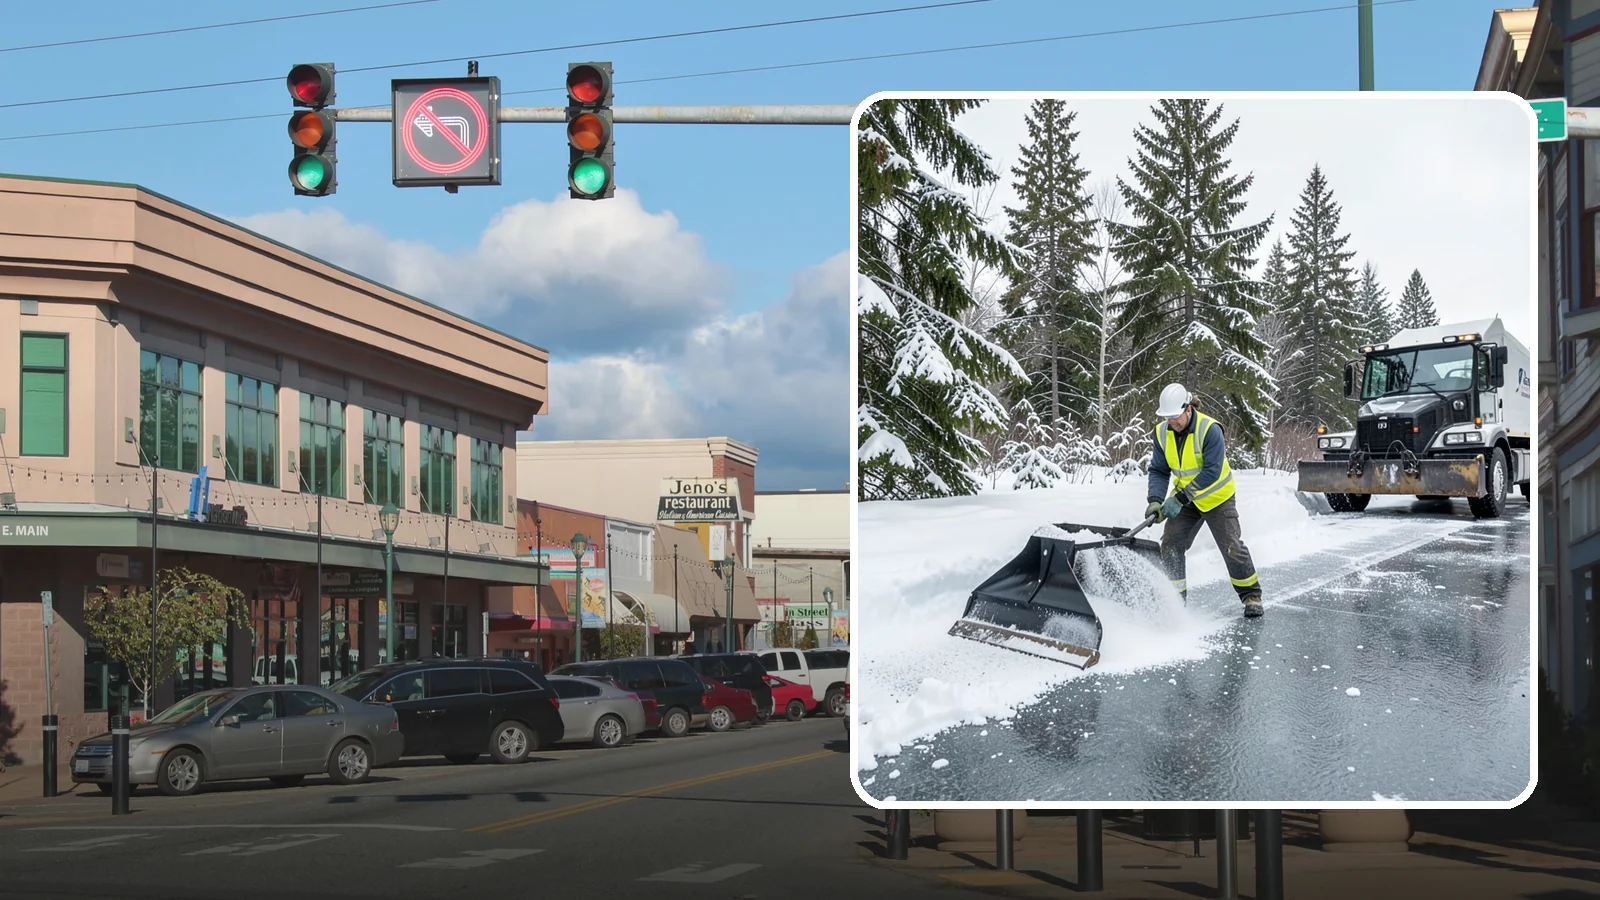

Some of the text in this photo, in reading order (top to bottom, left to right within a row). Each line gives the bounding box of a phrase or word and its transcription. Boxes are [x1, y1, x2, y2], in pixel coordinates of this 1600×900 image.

[670, 480, 728, 494] Jeno's
[665, 496, 731, 508] restaurant
[658, 510, 680, 519] Italian
[686, 510, 714, 519] American
[715, 510, 737, 519] Cuisine
[2, 525, 49, 536] E. MAIN
[798, 608, 828, 616] Street
